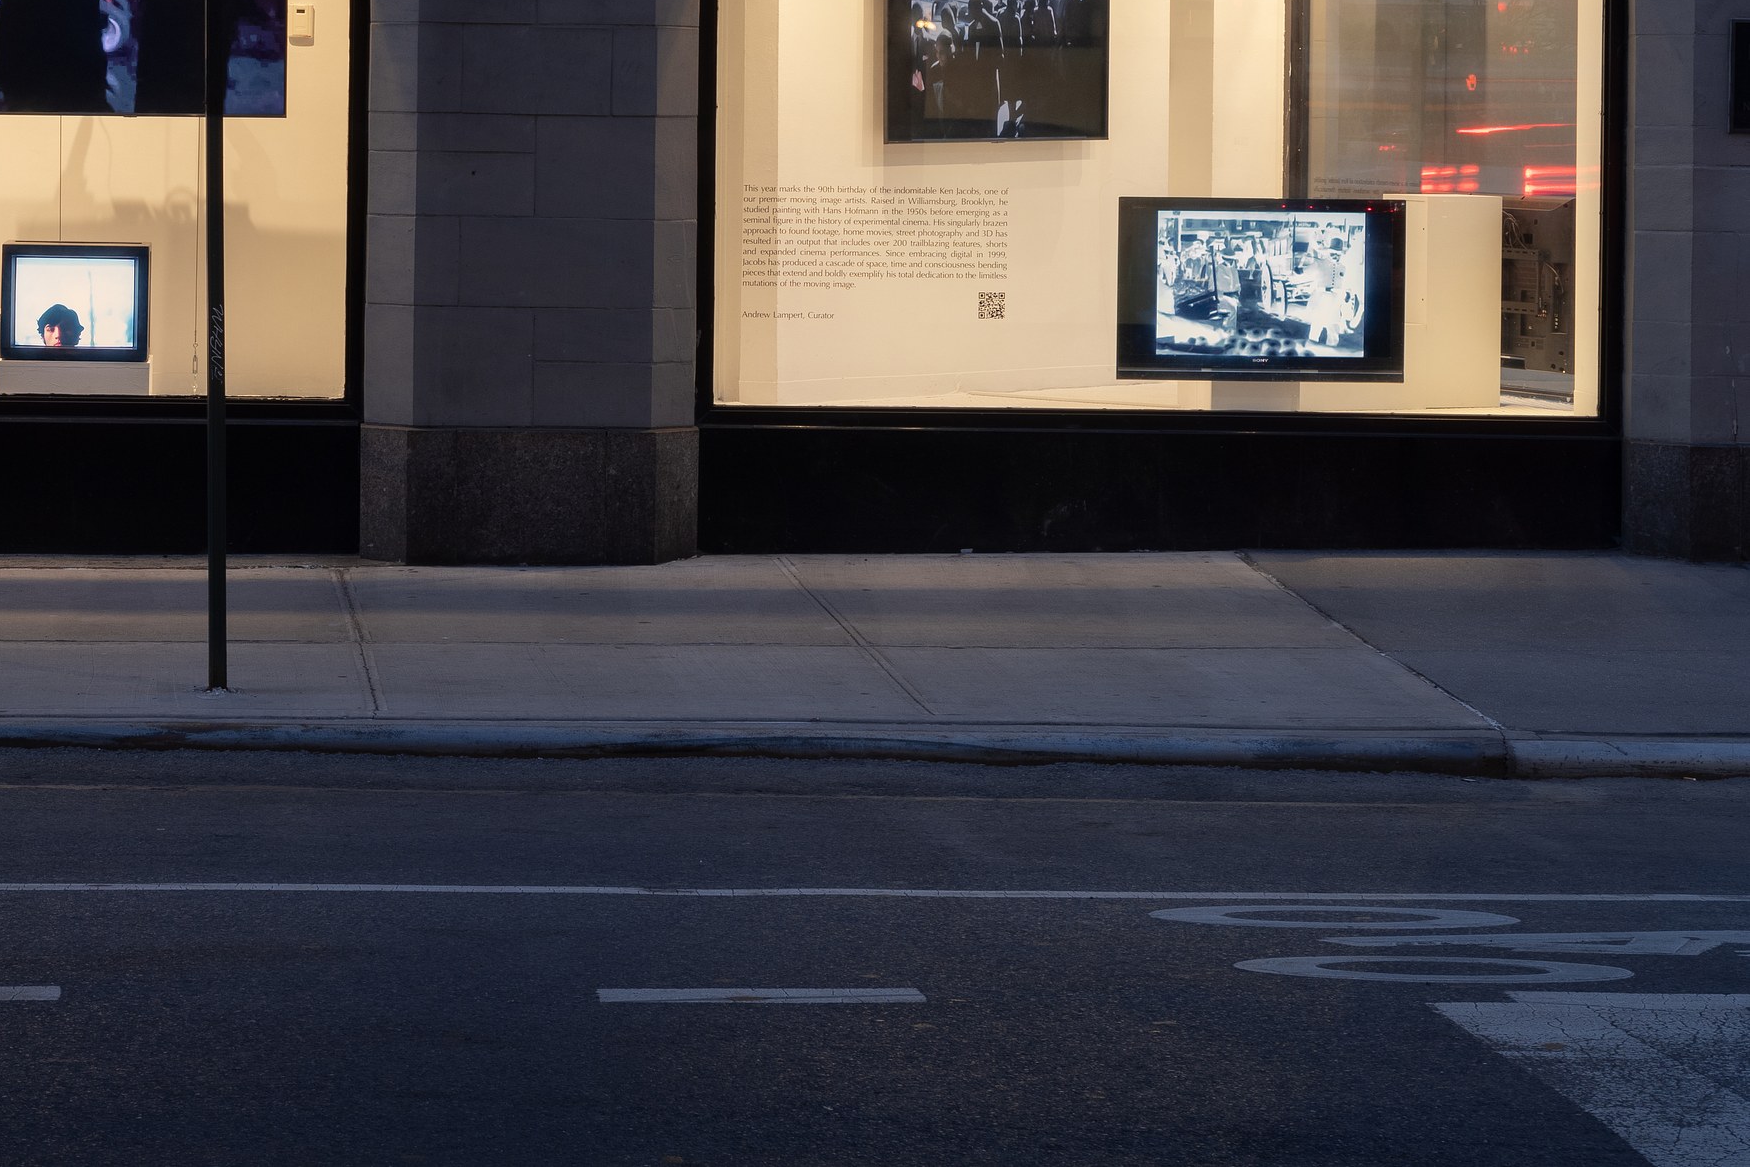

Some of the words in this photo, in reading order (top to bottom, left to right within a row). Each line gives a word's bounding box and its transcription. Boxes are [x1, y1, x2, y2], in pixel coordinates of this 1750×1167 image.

[745, 184, 758, 193] This
[761, 187, 776, 195] year
[779, 185, 801, 193] marks
[804, 185, 815, 194] the
[818, 185, 835, 194] 90th
[837, 186, 866, 196] birthday
[870, 186, 877, 194] of
[880, 186, 891, 194] the
[894, 186, 937, 195] indomitable
[940, 187, 954, 195] Ken
[956, 187, 981, 197] Jacobs,
[1001, 188, 1008, 196] of
[758, 196, 787, 206] premier
[790, 196, 817, 206] moving
[820, 197, 842, 207] image
[871, 197, 895, 205] Raised
[908, 197, 957, 208] Williamsburg,
[961, 198, 995, 209] Brooklyn,
[999, 198, 1008, 207] he
[744, 205, 770, 214] studied
[772, 206, 801, 217] painting
[804, 206, 820, 215] with
[823, 206, 841, 215] Hans
[845, 207, 879, 215] Hofmann
[891, 207, 903, 216] the
[907, 208, 927, 216] 1950s
[930, 208, 954, 216] before
[956, 209, 990, 219] emerging
[743, 216, 771, 224] seminal
[773, 216, 793, 227] figure
[804, 217, 816, 225] the
[818, 217, 841, 228] history
[844, 217, 852, 226] of
[853, 218, 901, 228] experimental
[933, 218, 945, 227] His
[947, 219, 981, 230] singularly
[983, 219, 1008, 228] brazen
[742, 226, 778, 237] approach
[789, 227, 810, 235] found
[812, 227, 840, 238] footage,
[843, 228, 864, 236] home
[866, 229, 893, 238] movies,
[918, 229, 963, 240] photography
[966, 229, 980, 238] and
[982, 229, 994, 238] 3D
[995, 230, 1008, 238] has
[743, 247, 757, 256] and
[760, 248, 796, 258] expanded
[830, 249, 882, 260] performances.
[886, 249, 905, 258] Since
[909, 250, 947, 260] embracing
[951, 250, 973, 261] digital
[989, 251, 1007, 260] 1999,
[773, 311, 804, 321] Lampert,
